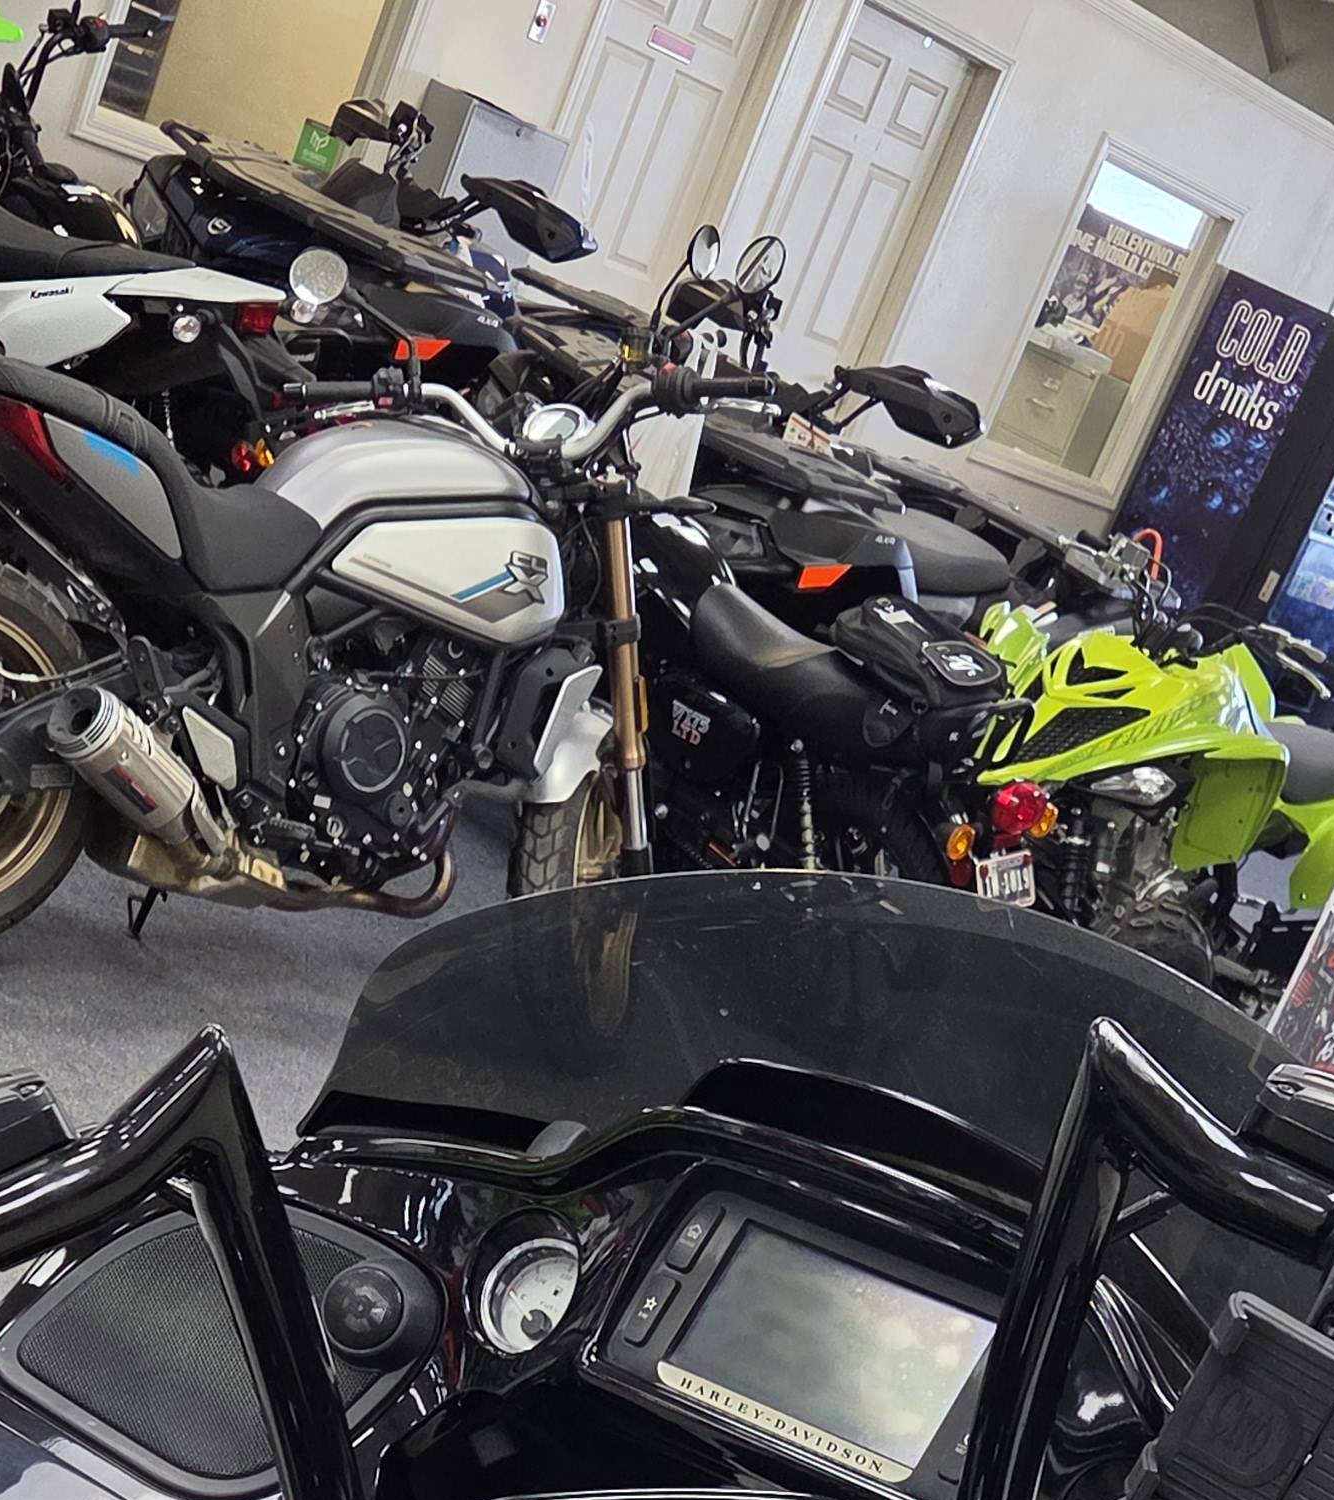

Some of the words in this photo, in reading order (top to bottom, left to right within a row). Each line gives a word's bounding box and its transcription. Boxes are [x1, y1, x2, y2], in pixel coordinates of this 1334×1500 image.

[1105, 223, 1173, 266] VALENTINO
[1216, 299, 1312, 385] COLD
[1193, 360, 1280, 431] drinks
[670, 719, 702, 746] LTD
[679, 1376, 885, 1475] HARLEY-DAVIDSON
